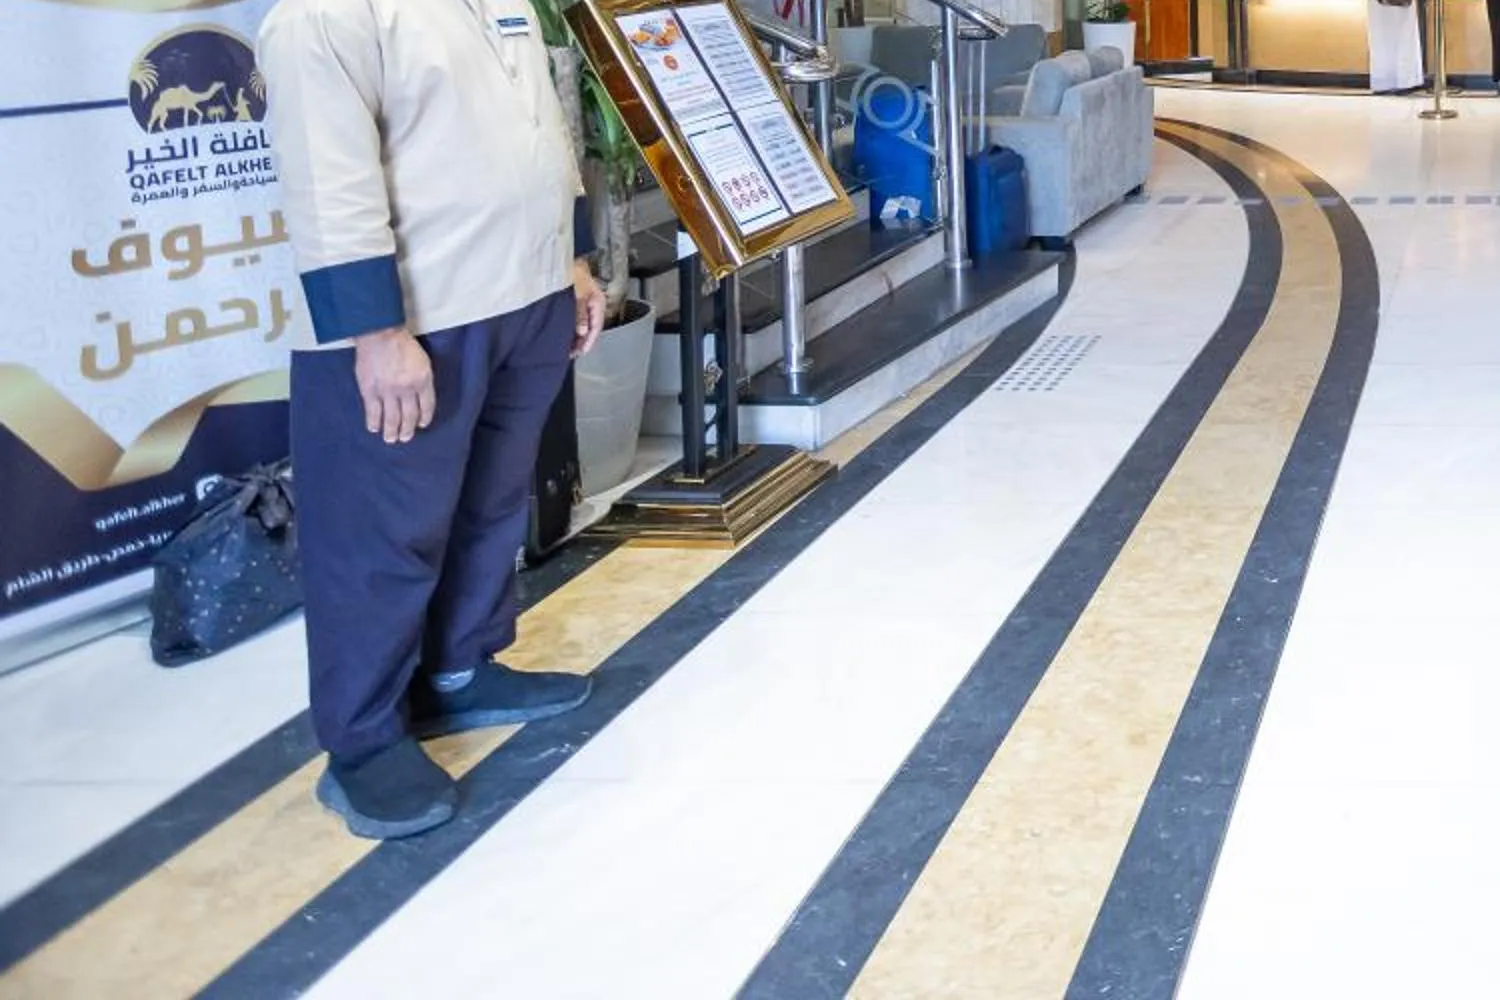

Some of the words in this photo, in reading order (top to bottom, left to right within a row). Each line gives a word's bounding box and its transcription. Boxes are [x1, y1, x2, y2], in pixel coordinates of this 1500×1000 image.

[125, 135, 199, 174] الخير
[209, 128, 271, 155] افلة
[129, 165, 209, 191] QAFELT
[214, 156, 273, 178] ALKHE
[71, 209, 291, 281] يوف
[79, 288, 292, 381] رحمن
